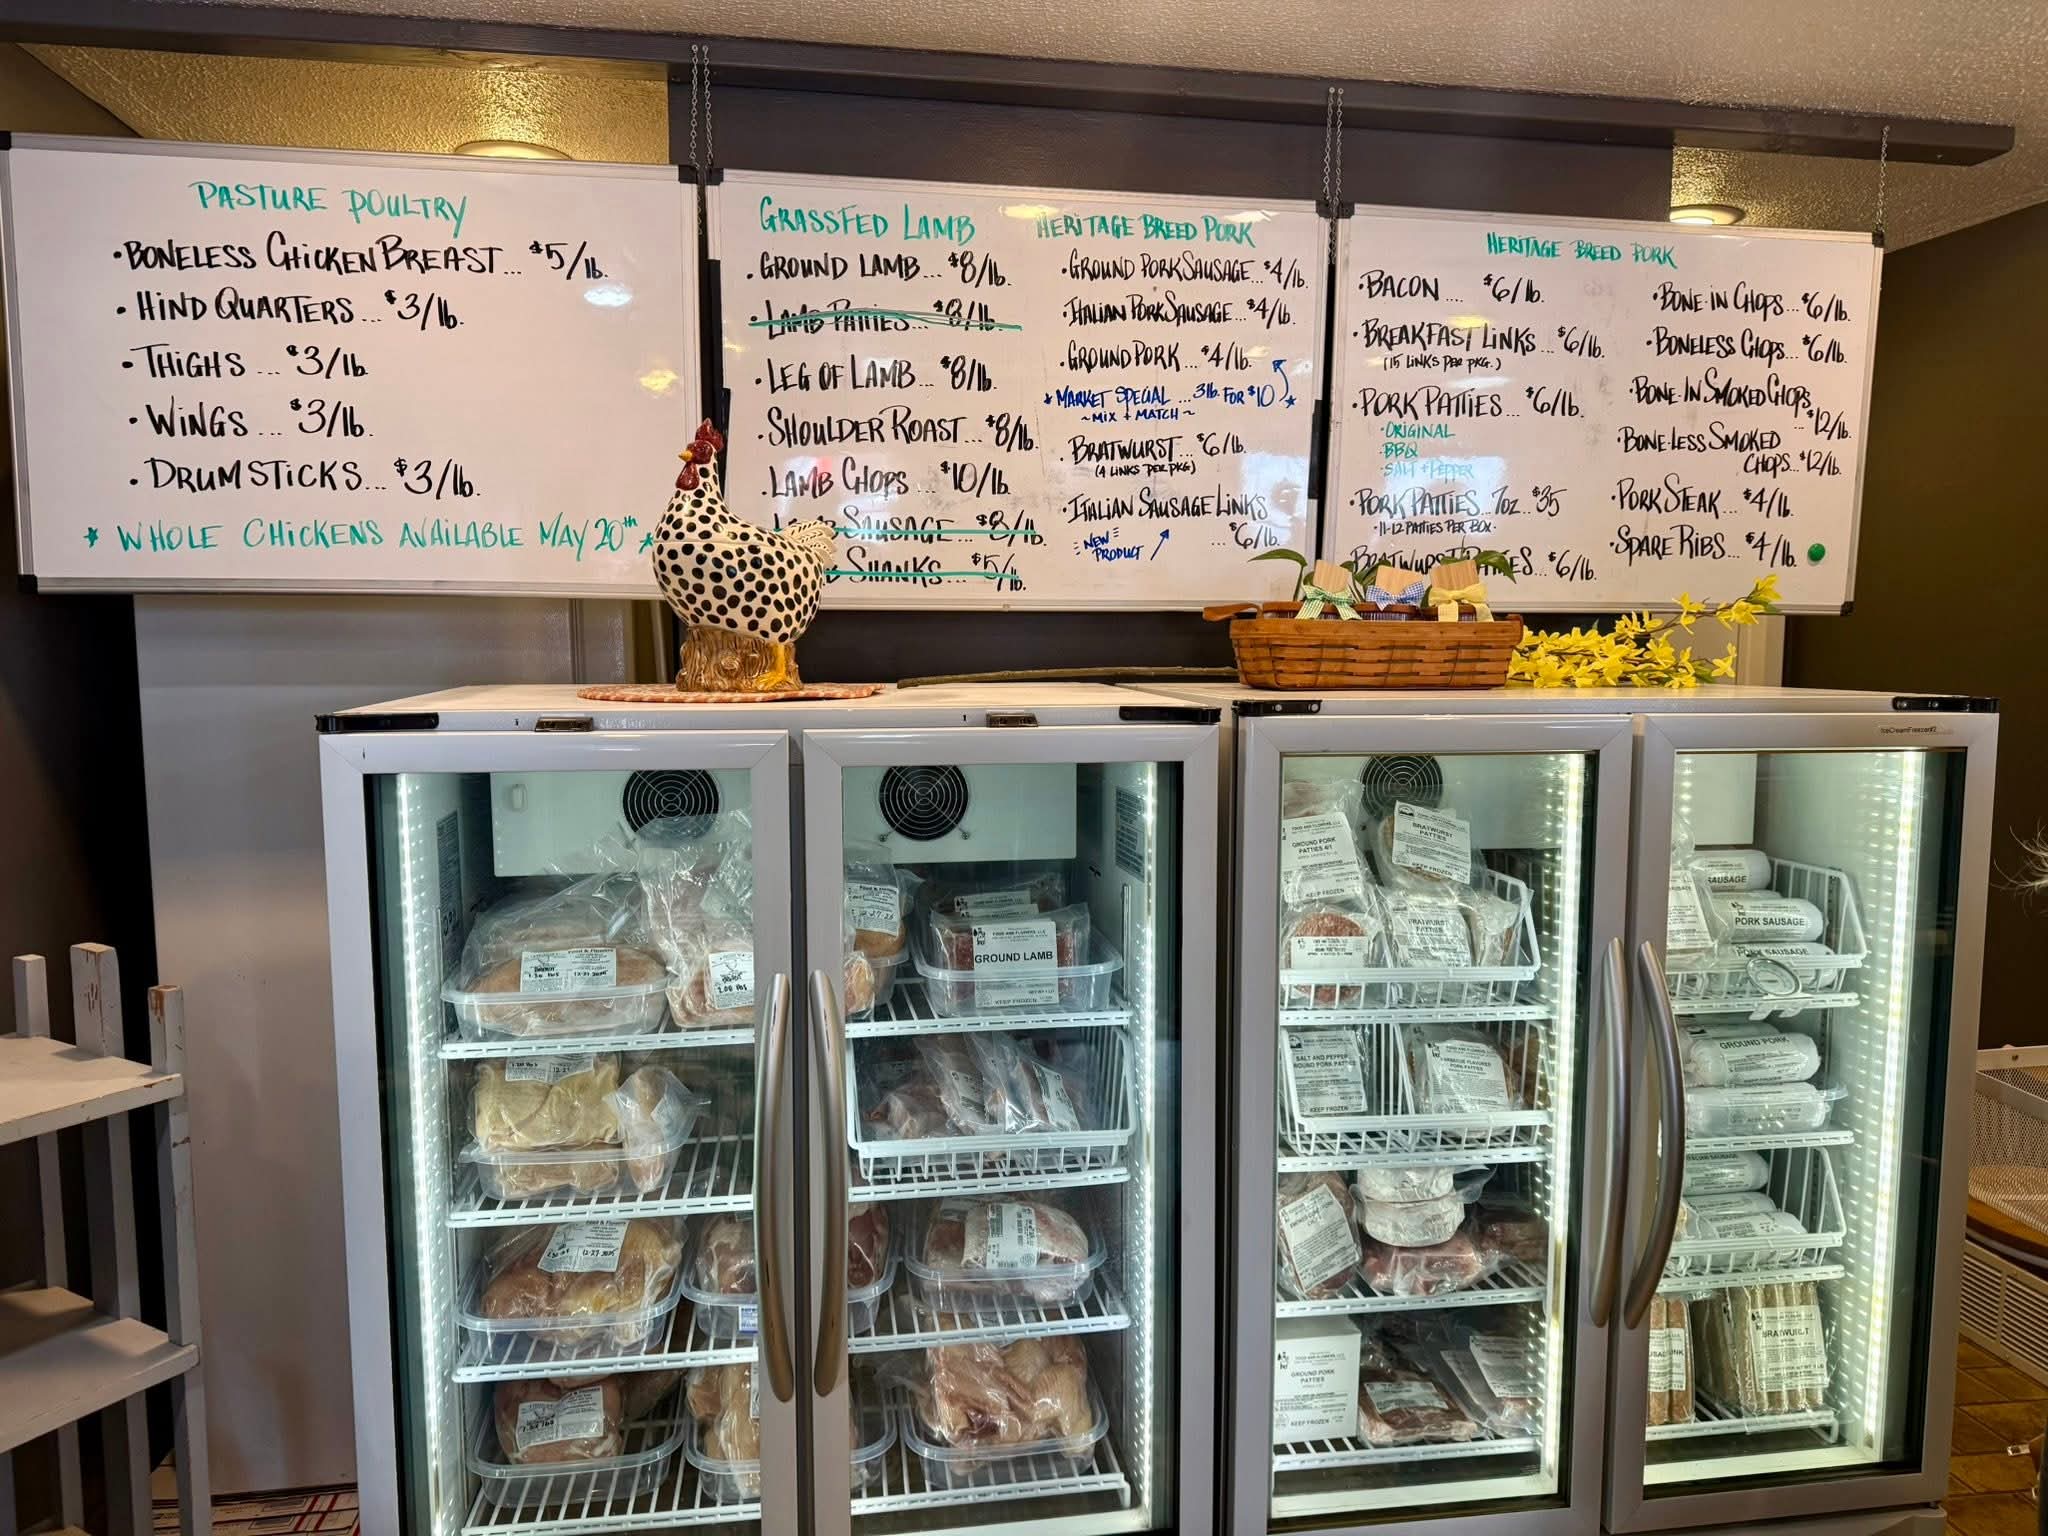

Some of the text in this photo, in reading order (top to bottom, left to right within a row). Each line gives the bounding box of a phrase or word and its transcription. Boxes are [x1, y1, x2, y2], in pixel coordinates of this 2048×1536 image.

[189, 179, 467, 238] PASTURE POULTRY
[760, 196, 975, 246] GRASSFED LAMB
[1037, 213, 1256, 248] HERITAGE BREED PORK
[126, 241, 256, 271] BONELESS
[529, 241, 608, 280] $5/lb.
[1486, 231, 1678, 269] HERITAGE BREED PORK
[760, 252, 848, 280] GROUND
[948, 251, 1012, 288] $8/lb.
[1070, 248, 1135, 281] GROUND
[1141, 253, 1183, 282] PORK
[1264, 257, 1309, 290] $4/lb.
[1360, 269, 1545, 304] BACON $6/lb.
[384, 289, 464, 330] $3/lb.
[766, 300, 824, 340] LAMB
[1126, 294, 1164, 321] PORK
[1247, 298, 1296, 329] $4/lb.
[1801, 291, 1851, 322] $6/lb.
[1362, 318, 1480, 352] BREAKFAST
[1557, 326, 1605, 358] $6/lb.
[1653, 326, 1736, 359] BONELESS
[1802, 333, 1848, 364] $6/lb.
[287, 344, 368, 378] $3/lb.
[1068, 340, 1132, 373] GROUND
[1201, 341, 1252, 371] $4/lb.
[767, 358, 810, 394] LEG
[819, 361, 845, 390] OF
[940, 355, 997, 392] $8/lb.
[1056, 385, 1112, 408] MARKET
[1224, 387, 1244, 405] FOR
[1247, 384, 1275, 408] $10
[1359, 387, 1419, 420] PORK
[1525, 386, 1584, 418] $6/lb.
[1704, 367, 1766, 407] SMOKED
[1767, 373, 1811, 418] CHOPS
[290, 398, 373, 438] $3/lb.
[768, 406, 885, 448] SHOULDER
[985, 412, 1039, 452] $8/lb.
[1385, 421, 1455, 438] ORIGINAL
[1806, 408, 1852, 441] $12/lb.
[1196, 432, 1247, 456] $6/lb.
[1383, 441, 1419, 459] BBQ
[1708, 421, 1781, 453] SMOKED
[395, 458, 480, 499] $3/lb.
[770, 465, 834, 499] LAMB
[940, 460, 1011, 498] $10/lb.
[1383, 461, 1416, 478] SALT
[1799, 450, 1841, 477] $12/lb.
[1139, 486, 1214, 519] SAUSAGE
[1355, 487, 1406, 520] PORK
[1532, 485, 1568, 517] $35
[1617, 477, 1663, 514] PORK
[1743, 487, 1794, 519] $4/lb.
[119, 523, 223, 552] WHOLE
[399, 522, 523, 548] AVAILABLE
[540, 513, 599, 560] MAY
[594, 516, 638, 548] 20th
[1084, 530, 1110, 549] NEW
[1229, 522, 1280, 549] $6/lb.
[1405, 522, 1443, 535] PATTIES
[1446, 522, 1467, 535] PER
[1092, 545, 1144, 561] PRODUCT
[1615, 524, 1673, 567] SPARE
[1745, 531, 1797, 568] $4/lb.
[1548, 549, 1597, 583] $6/lb.
[1412, 822, 1453, 838] BRATWURST
[1420, 830, 1447, 841] PATTIES
[1735, 917, 1805, 926] PORK SAUSAGE
[974, 950, 1054, 964] GROUND LAMB
[1720, 1038, 1761, 1049] GROUND
